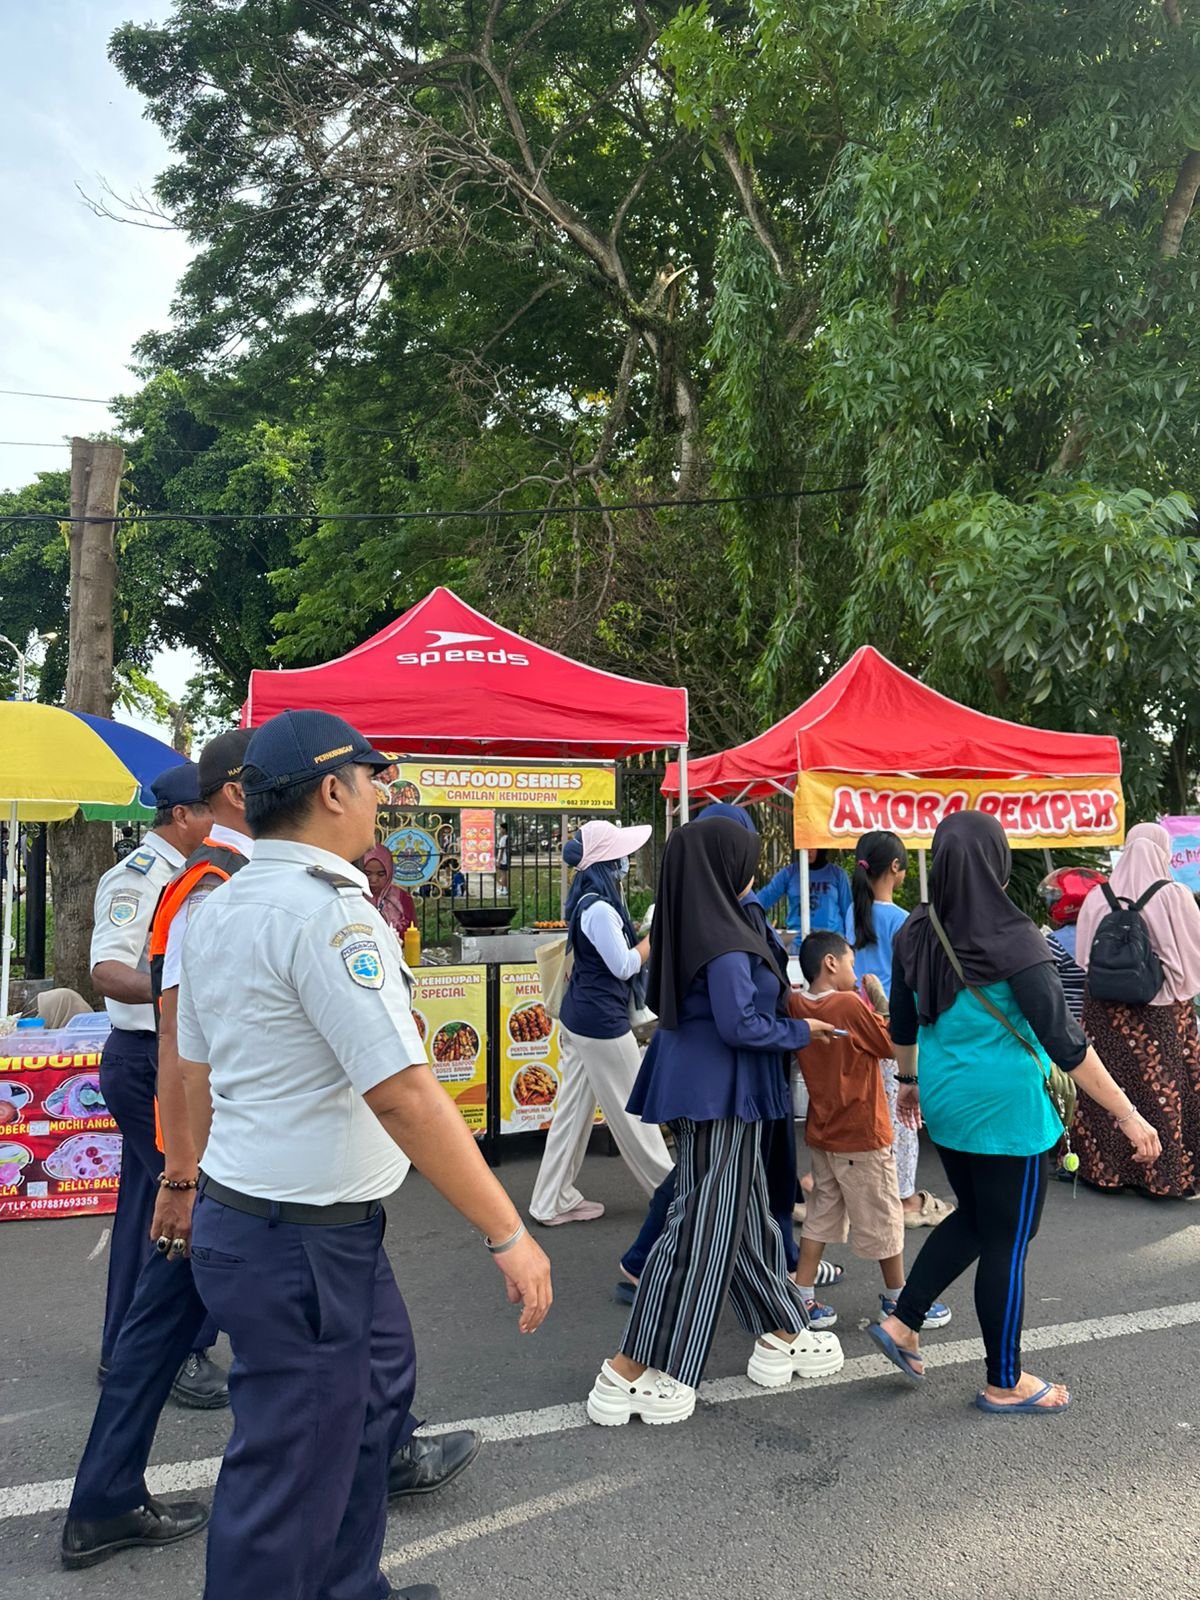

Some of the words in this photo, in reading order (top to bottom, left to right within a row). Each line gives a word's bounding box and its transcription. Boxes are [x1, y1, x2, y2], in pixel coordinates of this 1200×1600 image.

[396, 649, 529, 666] speeds
[420, 768, 513, 788] SEAFOOD
[515, 771, 583, 789] SERIES
[447, 790, 495, 801] CAMILAN
[499, 791, 558, 802] KEHIDUPAN
[831, 787, 966, 833] AMORA
[421, 974, 480, 986] KEHIDUPAN
[502, 972, 540, 984] CAMILA
[421, 987, 466, 999] SPECIAL
[49, 1119, 84, 1131] MOCHI
[87, 1118, 117, 1129] ANGG
[57, 1179, 91, 1192] JELLY
[31, 1196, 99, 1209] 087887693358
